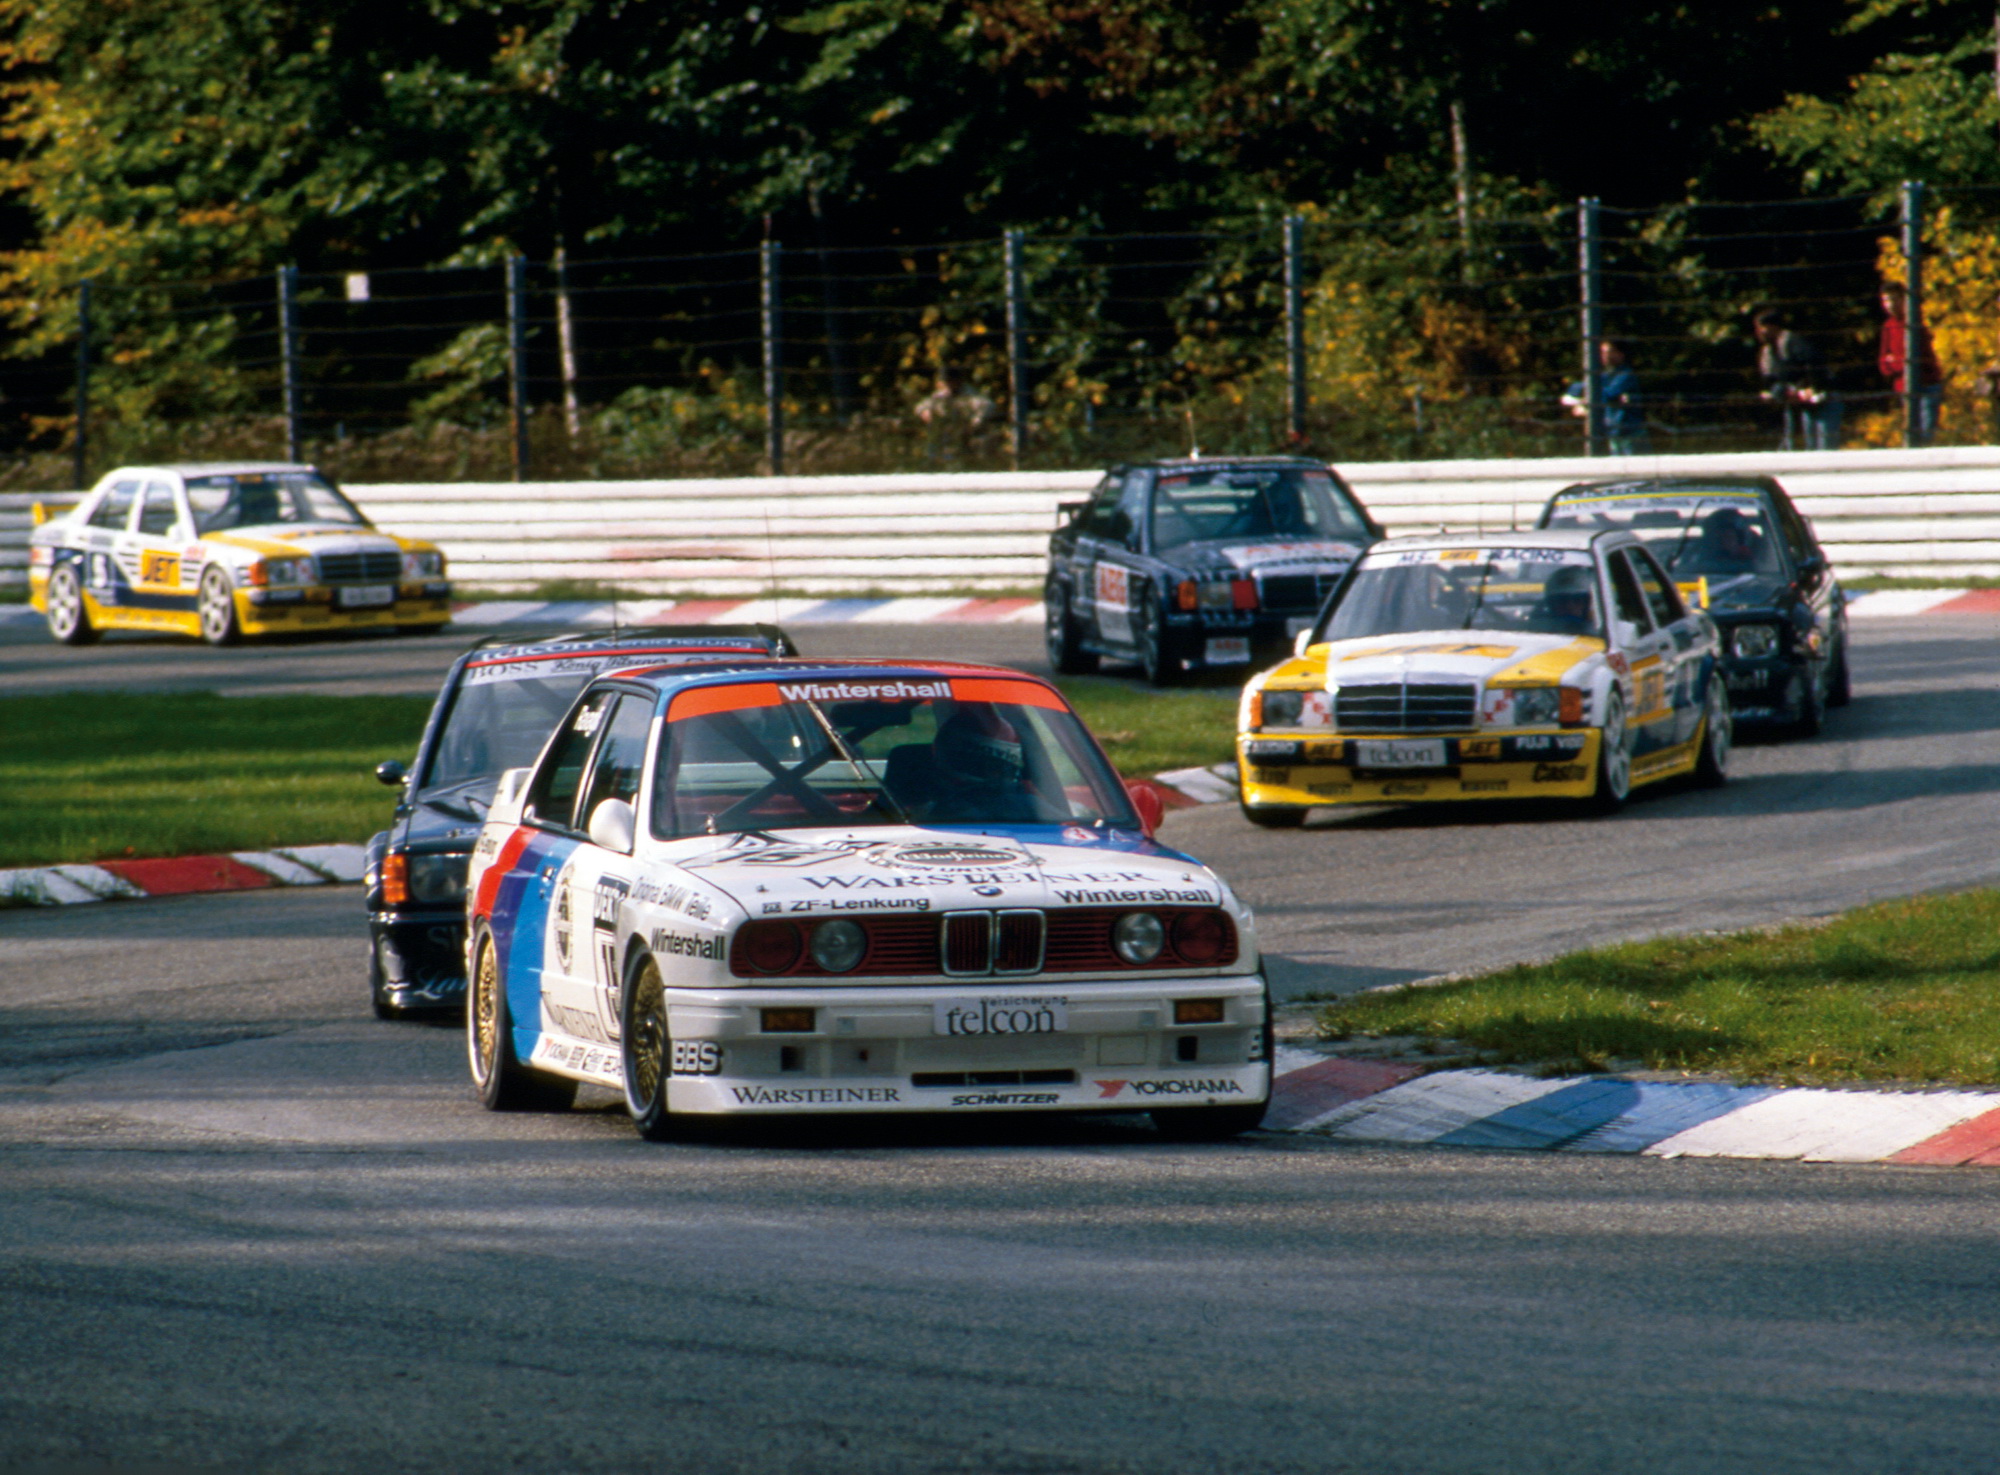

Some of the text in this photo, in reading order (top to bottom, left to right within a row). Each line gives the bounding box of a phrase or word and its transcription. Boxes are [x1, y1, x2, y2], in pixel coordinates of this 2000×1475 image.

[143, 556, 176, 583] JET
[779, 680, 952, 701] Wintershall
[1370, 743, 1434, 763] telcon
[801, 873, 1160, 889] WARSTEINER
[790, 898, 931, 911] ZF-Lenkung
[1055, 888, 1214, 904] Wintershall
[651, 927, 726, 961] Wintershall
[946, 1001, 1056, 1035] telcon
[671, 1040, 722, 1075] BBS
[731, 1079, 1243, 1106] WARSTEINER SCHNITZER YOKOHAMA
